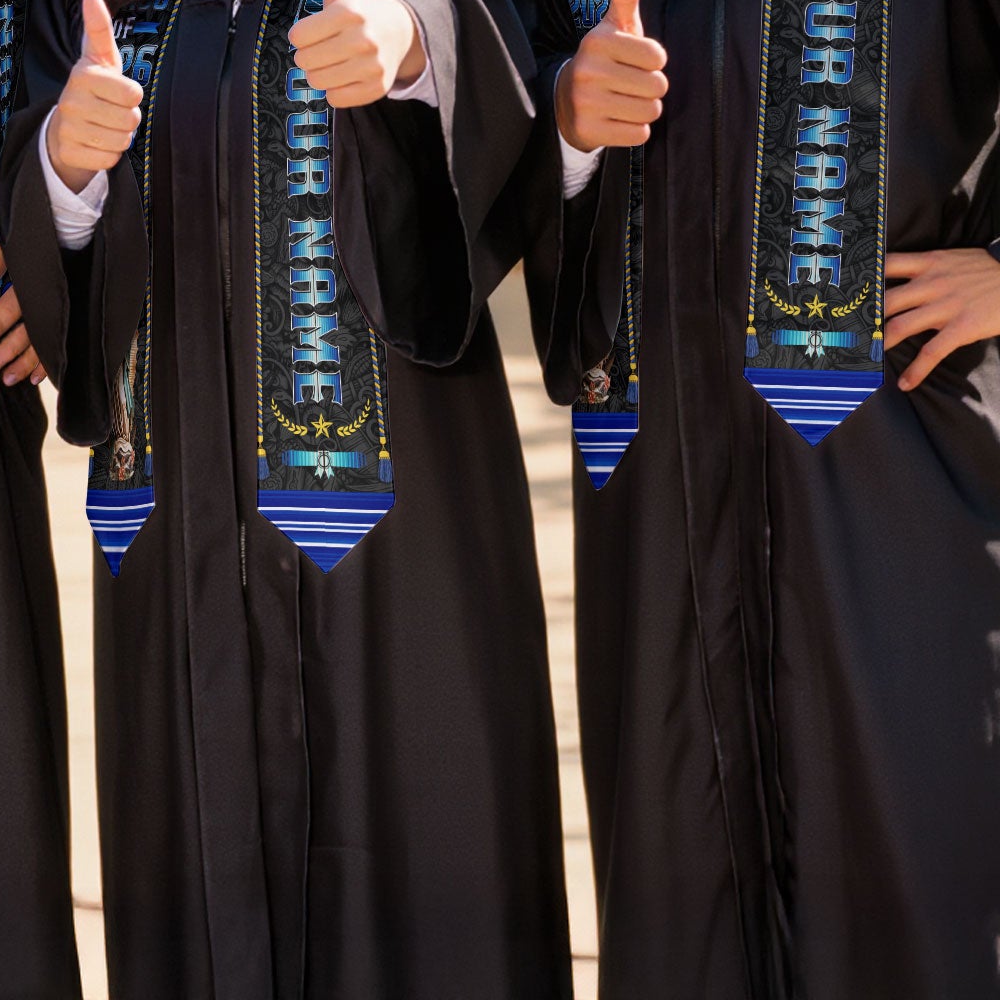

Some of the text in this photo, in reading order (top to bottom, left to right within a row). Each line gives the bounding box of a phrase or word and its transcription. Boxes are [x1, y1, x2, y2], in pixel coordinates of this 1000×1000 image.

[286, 44, 343, 406] OUR NAME
[787, 104, 850, 287] NAME
